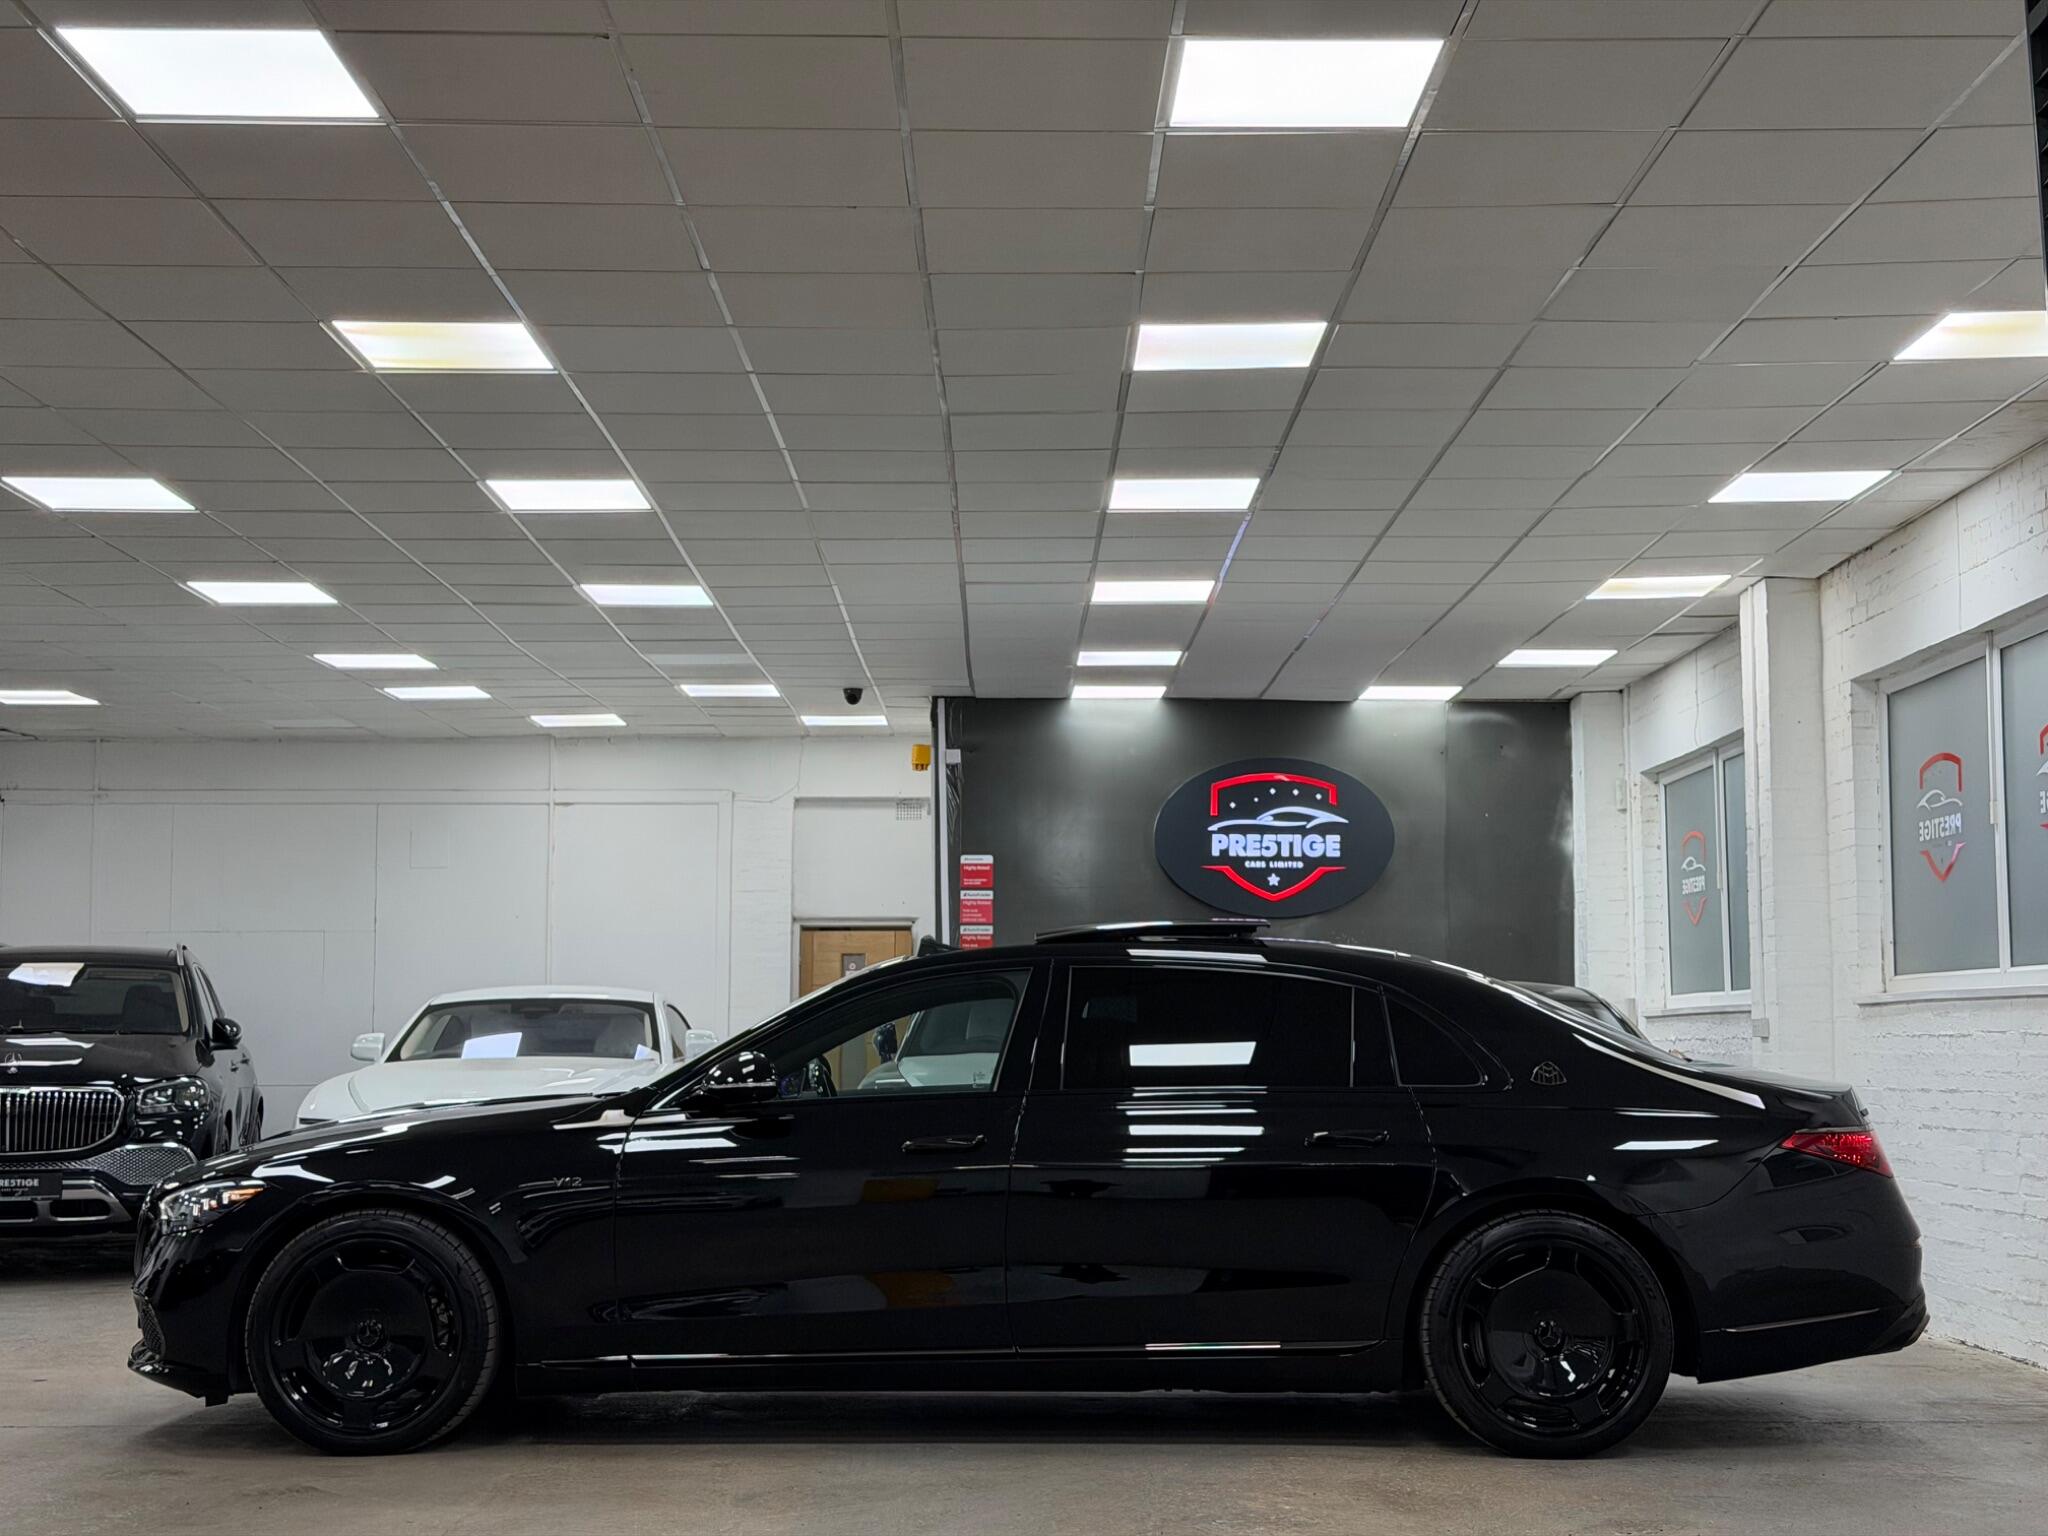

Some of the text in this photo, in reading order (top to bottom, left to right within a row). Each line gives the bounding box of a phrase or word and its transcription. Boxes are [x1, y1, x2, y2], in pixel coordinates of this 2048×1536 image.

[1244, 860, 1304, 869] CARS LIMITED
[553, 1177, 582, 1187] V12
